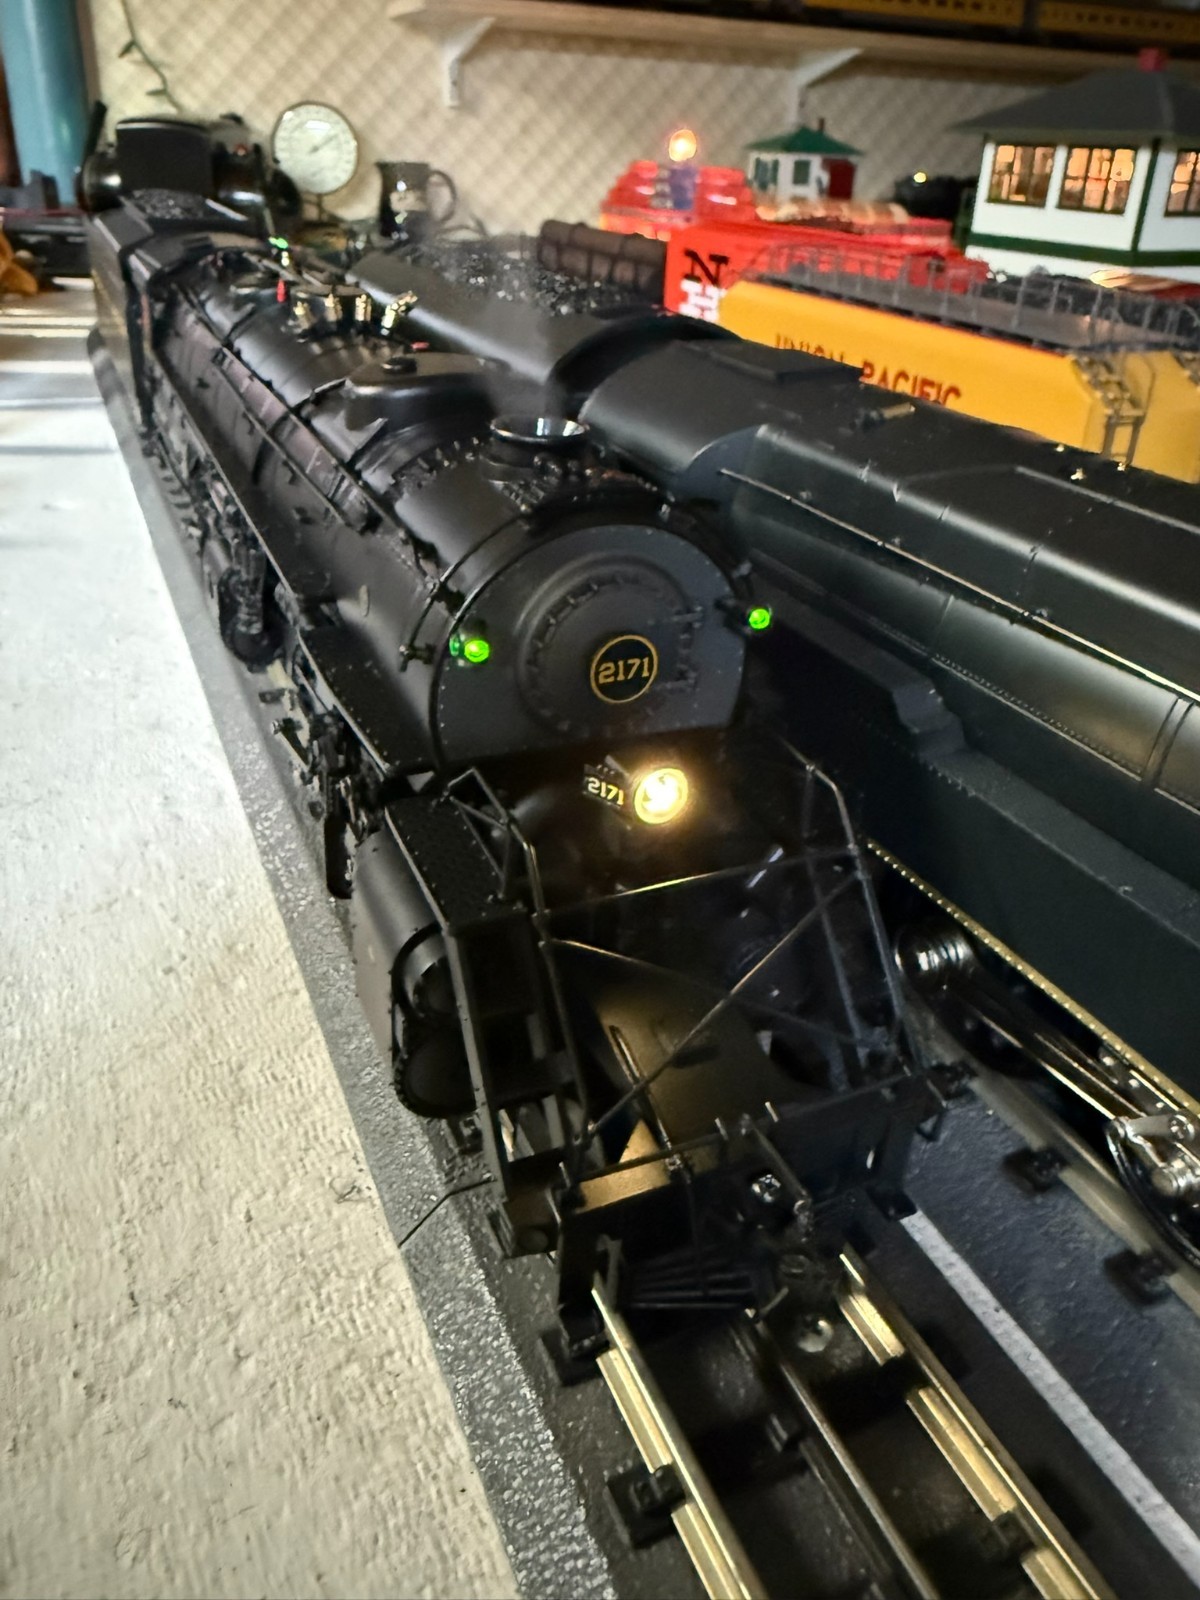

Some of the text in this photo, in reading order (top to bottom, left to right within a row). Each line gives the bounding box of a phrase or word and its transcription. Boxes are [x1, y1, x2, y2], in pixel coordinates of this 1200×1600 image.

[683, 249, 729, 289] N
[861, 360, 961, 406] PACIFIC
[598, 657, 650, 684] 2171
[588, 777, 624, 805] 2171
